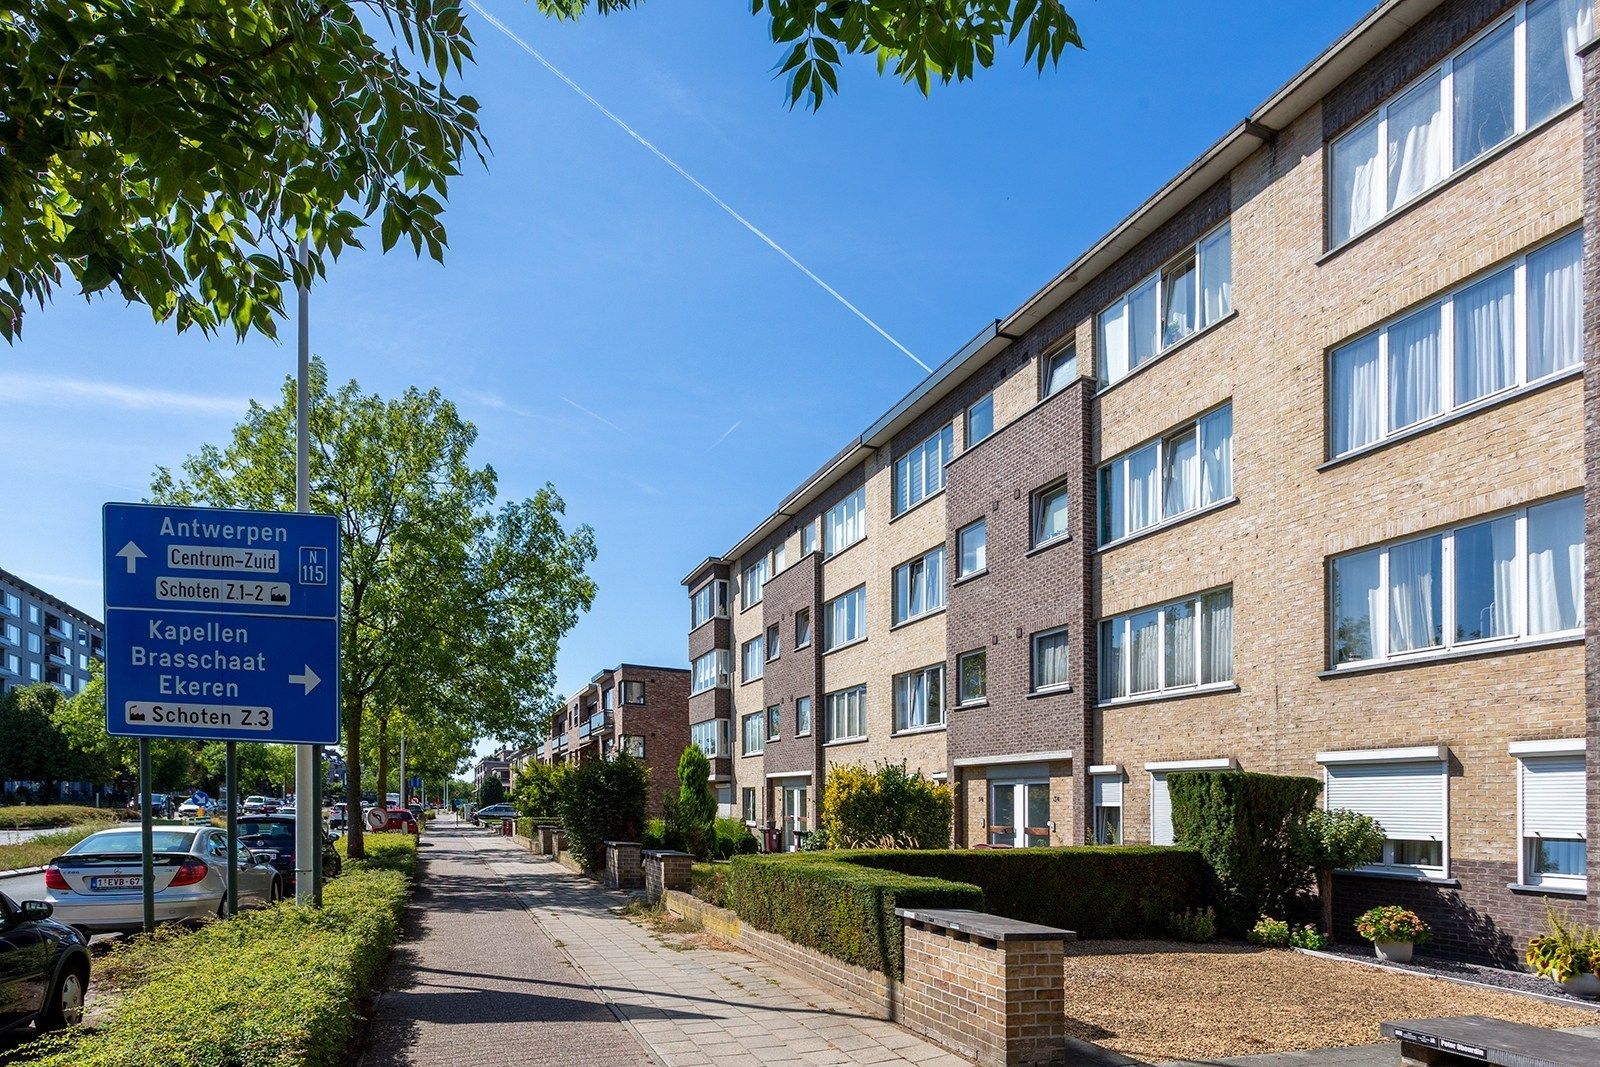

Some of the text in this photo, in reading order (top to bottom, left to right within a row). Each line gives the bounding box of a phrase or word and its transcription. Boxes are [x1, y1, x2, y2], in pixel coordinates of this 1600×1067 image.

[160, 516, 287, 545] Antwerpen
[171, 548, 276, 570] Centrum-Zuid
[309, 550, 317, 564] N
[302, 565, 324, 582] 115
[159, 580, 264, 601] Schoten Z.1-2
[149, 619, 248, 645] Kapellen
[131, 646, 266, 671] Brasschaat
[159, 674, 239, 698] Ekeren
[152, 705, 270, 727] Schoten Z.3
[98, 877, 144, 887] 1-EVB-67
